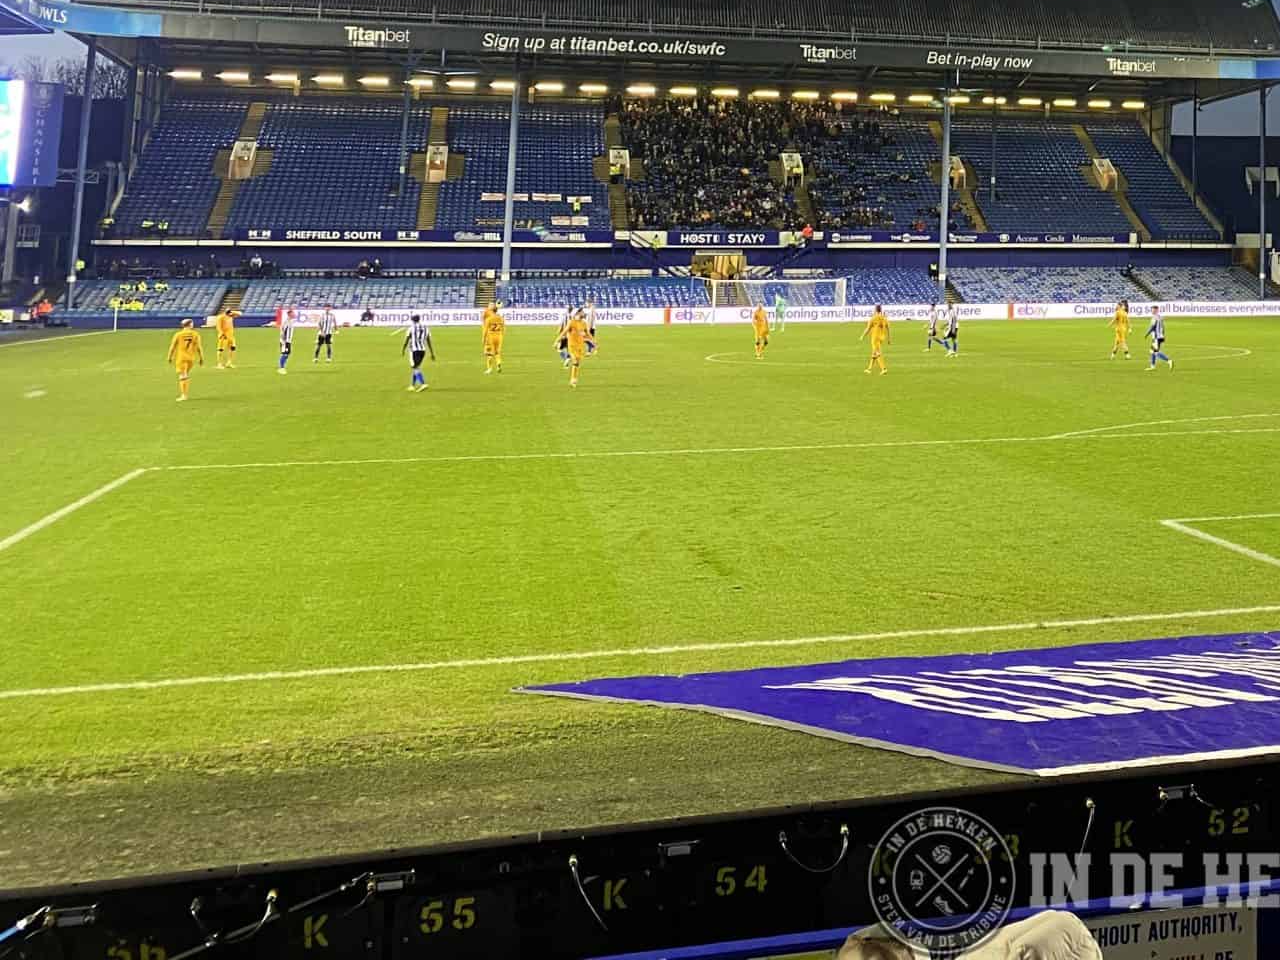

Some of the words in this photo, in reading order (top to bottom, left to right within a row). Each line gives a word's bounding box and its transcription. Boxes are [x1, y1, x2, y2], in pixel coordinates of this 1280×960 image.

[344, 26, 411, 43] Titanbet
[482, 32, 520, 50] Sign
[524, 35, 545, 52] up
[550, 36, 566, 50] at
[570, 35, 726, 56] titanbet.co.uk/swfc
[800, 44, 857, 60] Titanbet
[927, 51, 951, 65] Bet
[954, 52, 1001, 69] in-play
[1003, 56, 1033, 68] now
[1106, 58, 1156, 73] Titanbet
[286, 230, 341, 240] SHEFFIELD
[343, 231, 382, 240] SOUTH
[727, 233, 760, 244] STAY
[675, 308, 711, 324] ebay
[1017, 304, 1049, 318] ebay
[1172, 302, 1227, 314] businesses
[1113, 820, 1133, 848] K
[1207, 806, 1249, 837] 52
[603, 878, 628, 911] K
[715, 864, 768, 897] 54
[303, 913, 329, 949] K
[419, 897, 476, 934] 55
[1148, 912, 1243, 943] AUTHORITY,
